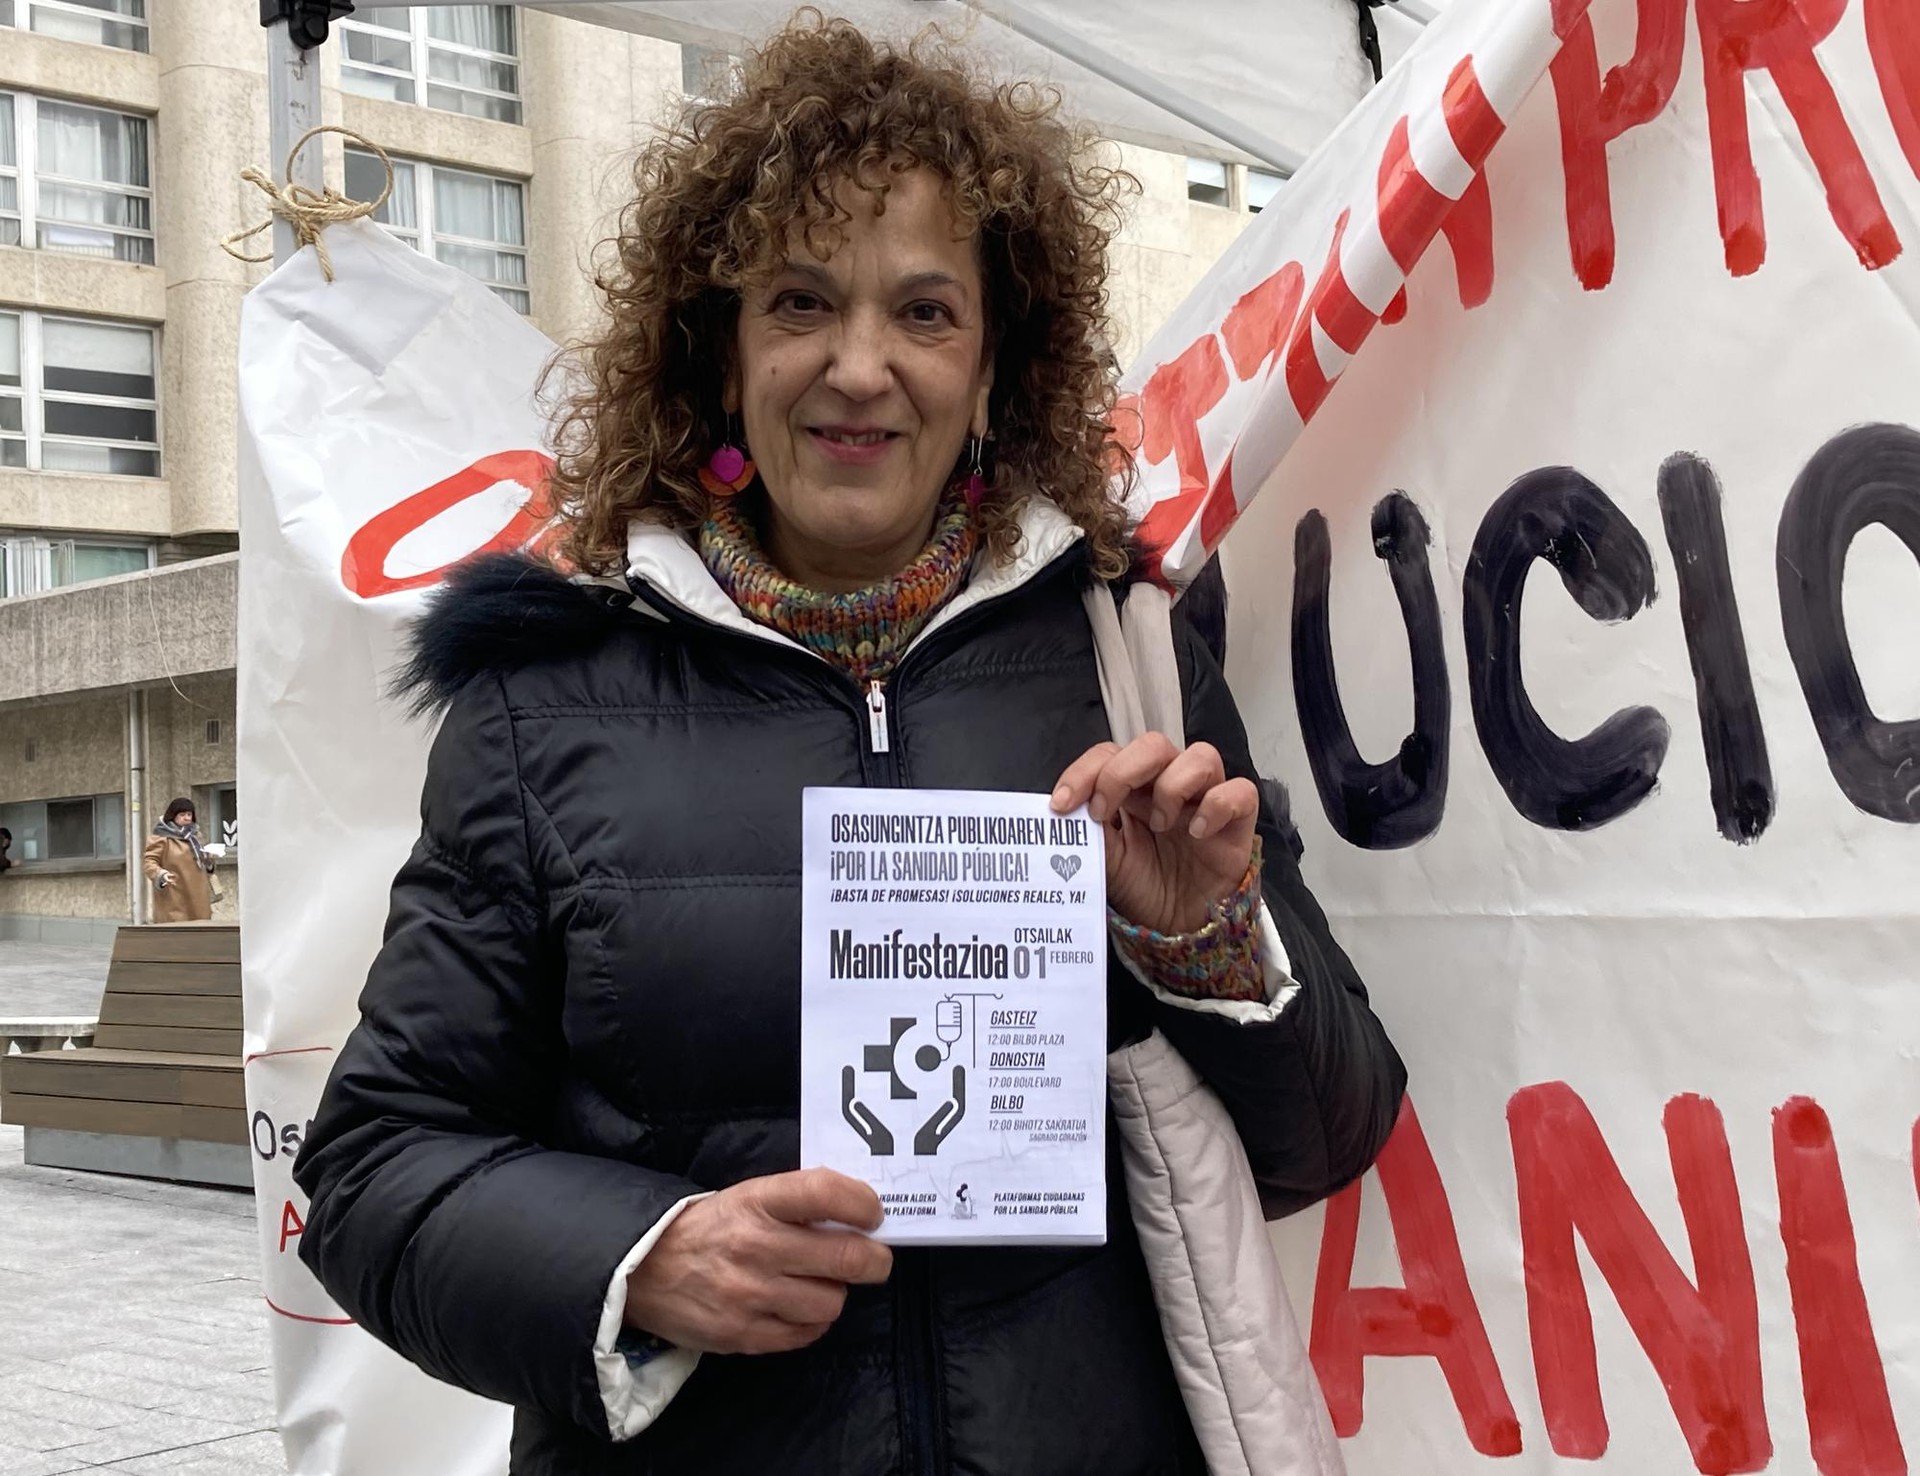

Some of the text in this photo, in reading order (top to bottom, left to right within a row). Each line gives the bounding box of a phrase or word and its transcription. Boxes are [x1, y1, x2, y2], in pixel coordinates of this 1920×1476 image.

[1548, 0, 1920, 291] PR
[1171, 422, 1920, 850] UCIO
[831, 814, 1088, 847] OSASUNGINTZA PUBLIKOAREN ALDE!
[831, 847, 1029, 882] ¡POR LA SANIDAD PÚBLICA!
[830, 889, 1086, 905] ¡BASTA DE PROMESAS! ¡SOLUCIONES REALES, YA!
[1014, 928, 1073, 944] OTSAILAK
[830, 929, 1009, 979] Manifestazioa
[1014, 946, 1094, 979] 01 FEBRERO
[990, 1010, 1038, 1026] GASTEIZ
[988, 1033, 1065, 1045] 12:00 BILBO PLAZA
[990, 1051, 1046, 1067] DONOSTIA
[989, 1076, 1062, 1088] 17:00 BOULEVARD
[990, 1095, 1024, 1110] BILBO
[989, 1119, 1087, 1131] 12:00 BIHOTZ SAKRATUA
[252, 1111, 316, 1161] Os
[994, 1192, 1086, 1202] PLATAFORMAS CIUDADANAS
[892, 1206, 937, 1216] PLATAFORMA
[993, 1205, 1007, 1215] POR
[1009, 1205, 1017, 1215] LA
[1019, 1205, 1049, 1215] SANIDAD
[1310, 1081, 1920, 1476] ANI
